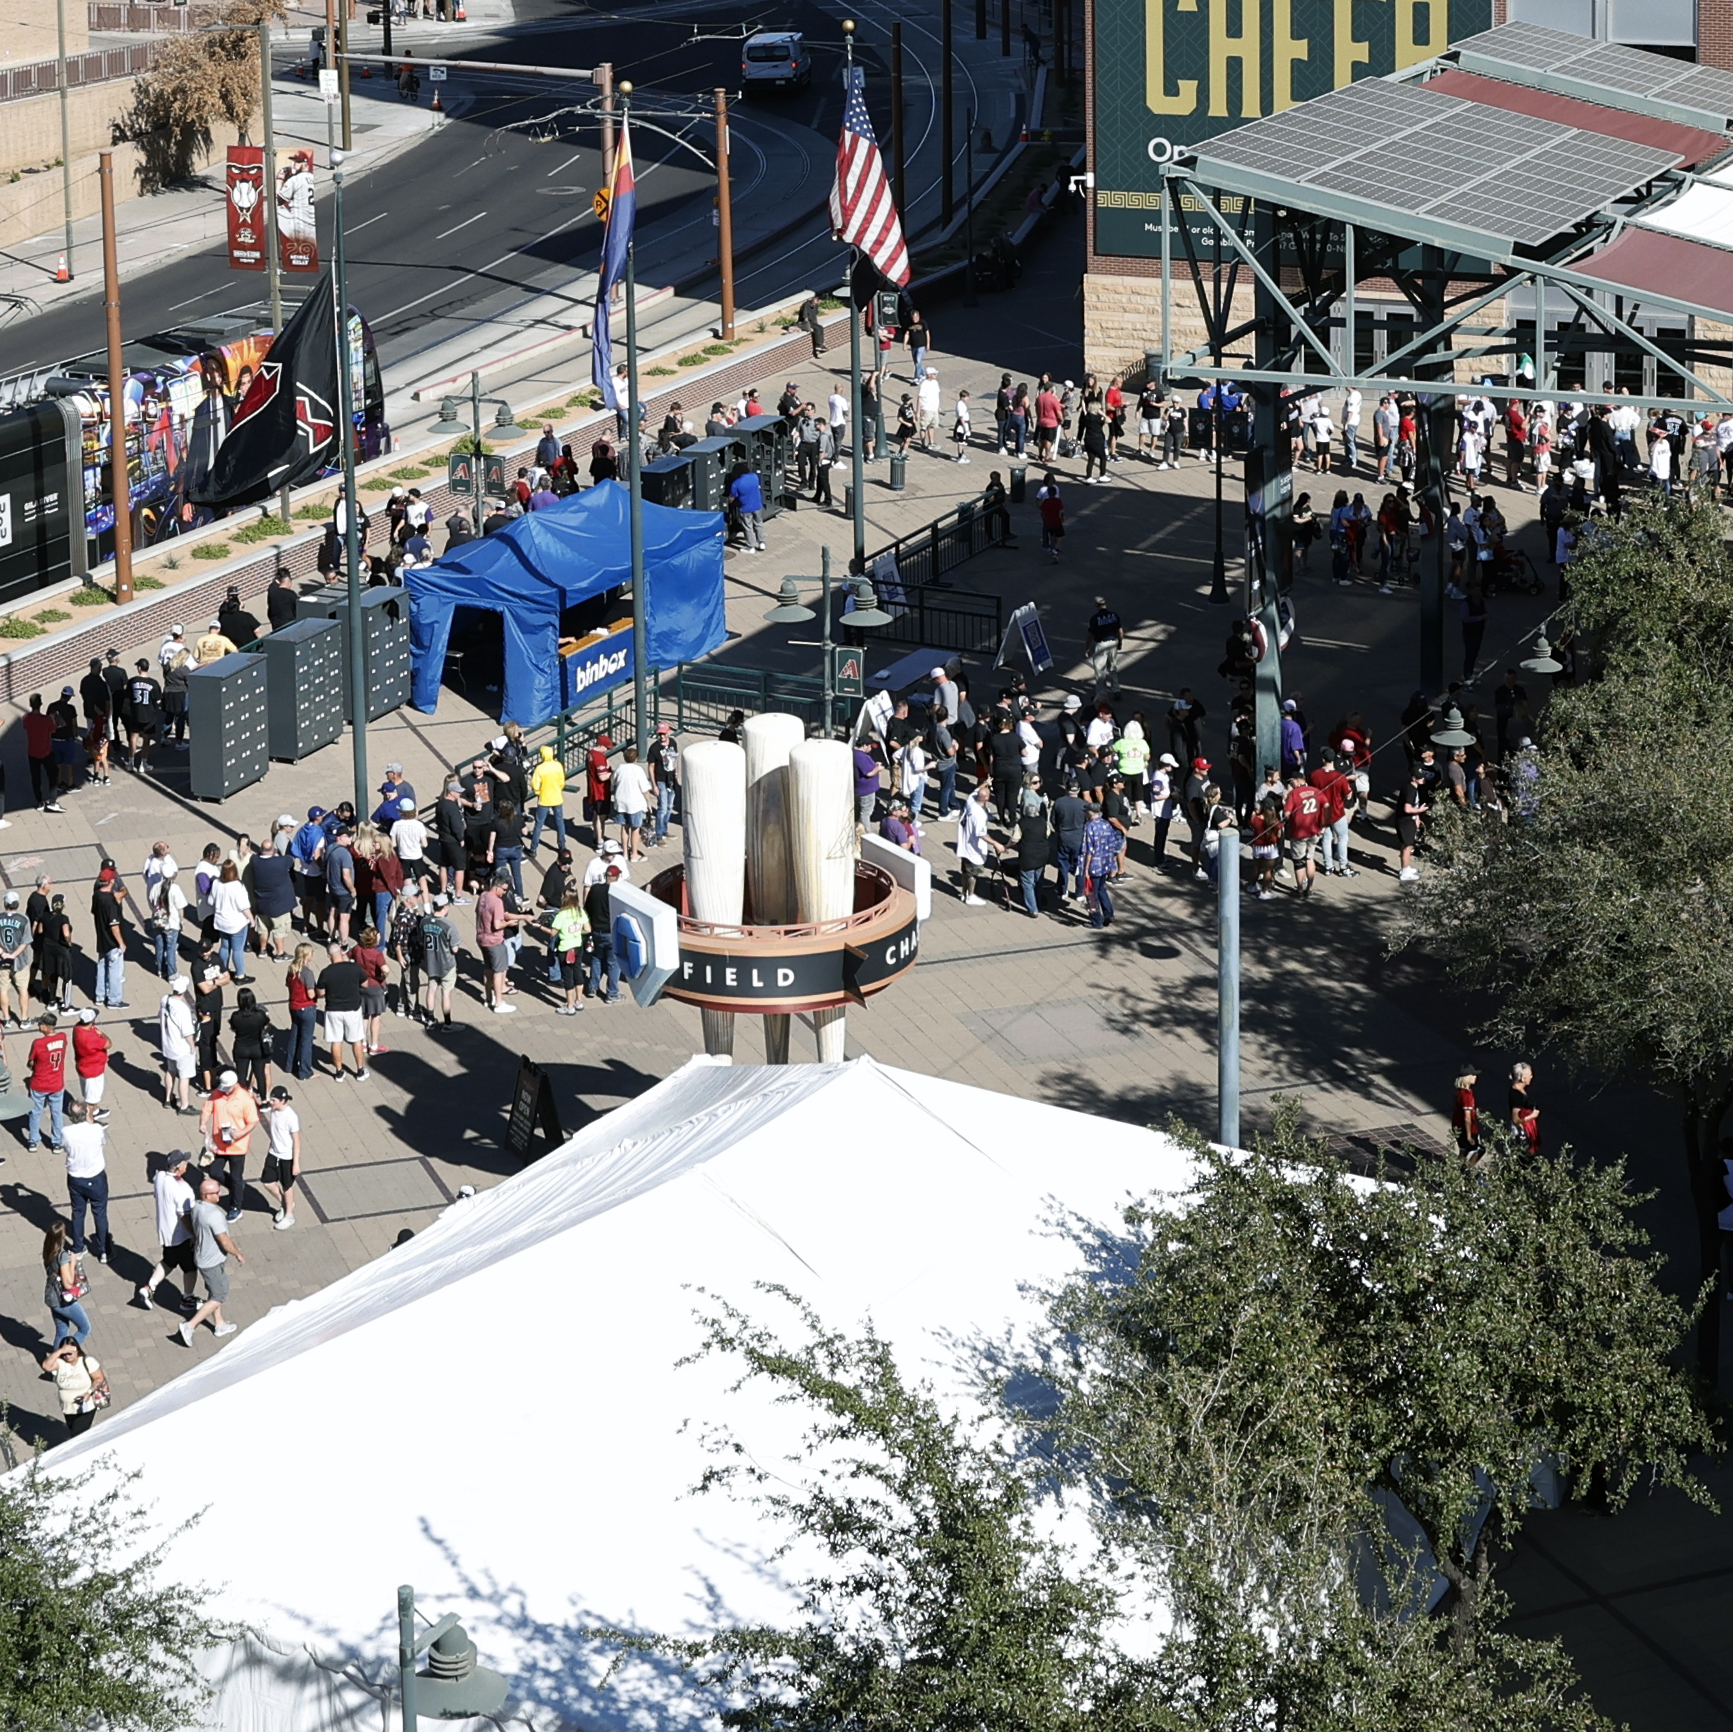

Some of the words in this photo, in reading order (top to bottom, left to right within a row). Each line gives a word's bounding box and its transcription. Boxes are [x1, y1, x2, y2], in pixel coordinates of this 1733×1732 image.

[575, 648, 628, 693] binbox
[132, 689, 149, 705] 31
[1302, 797, 1318, 815] 22
[4, 927, 14, 945] 6
[425, 933, 438, 951] 21
[682, 961, 795, 988] FIELD
[884, 930, 919, 965] CHA
